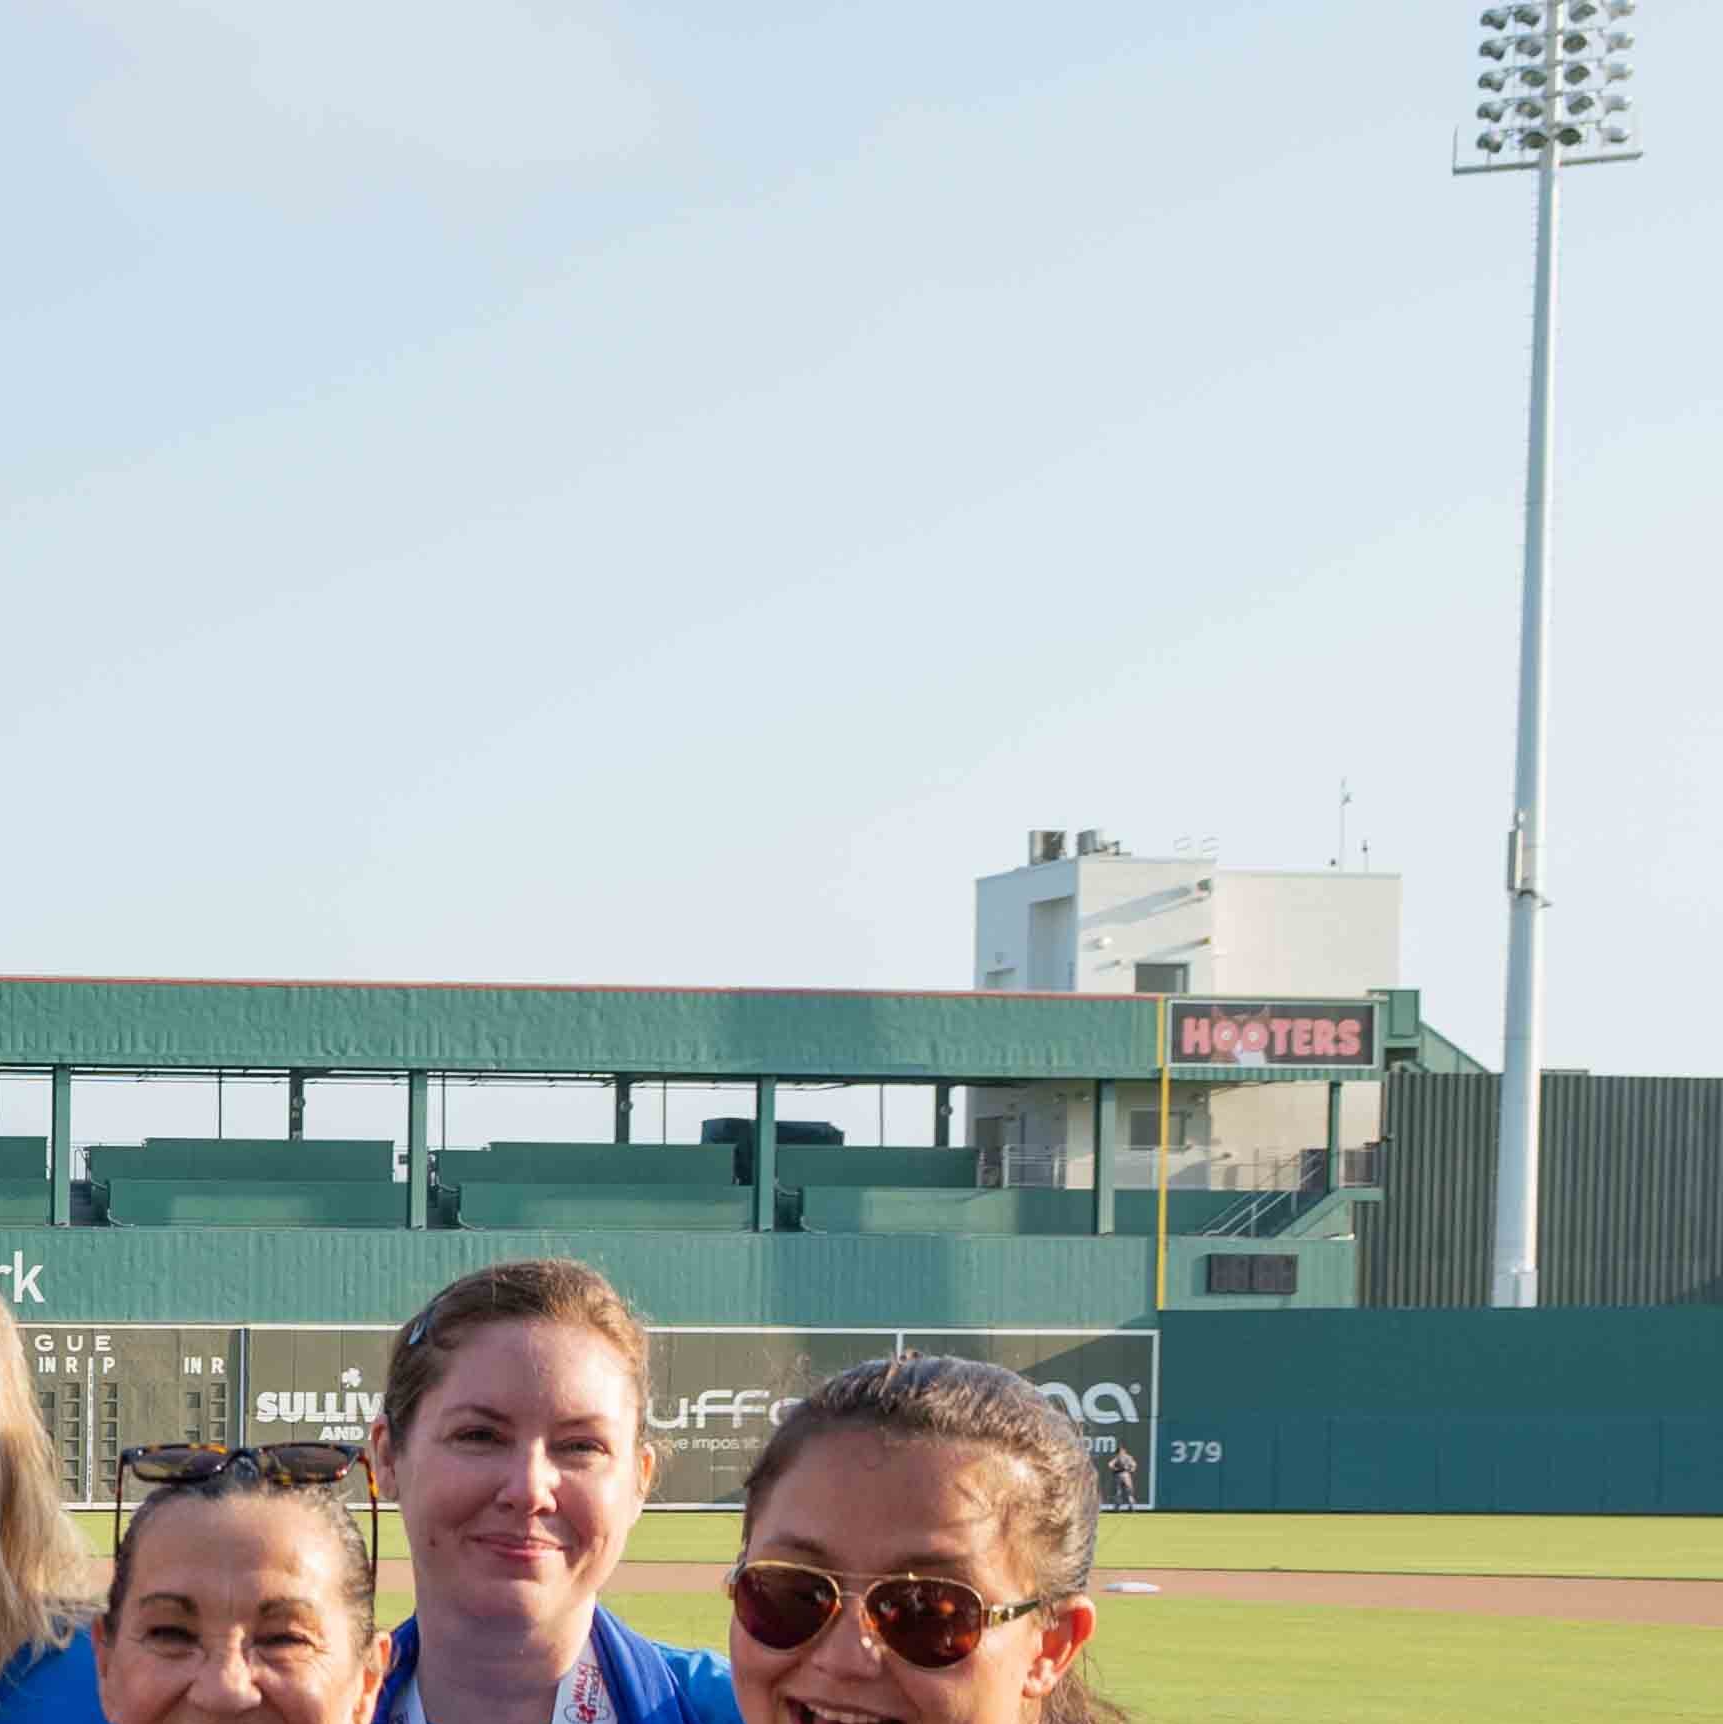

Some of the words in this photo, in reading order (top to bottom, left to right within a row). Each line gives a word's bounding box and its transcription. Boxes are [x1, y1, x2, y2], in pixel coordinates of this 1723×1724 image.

[1182, 1016, 1362, 1056] HOOTERS
[38, 1357, 56, 1373] IN
[66, 1357, 78, 1373] R
[184, 1357, 202, 1374] IN
[211, 1357, 224, 1374] R
[318, 1426, 364, 1441] AND
[1170, 1441, 1223, 1464] 379
